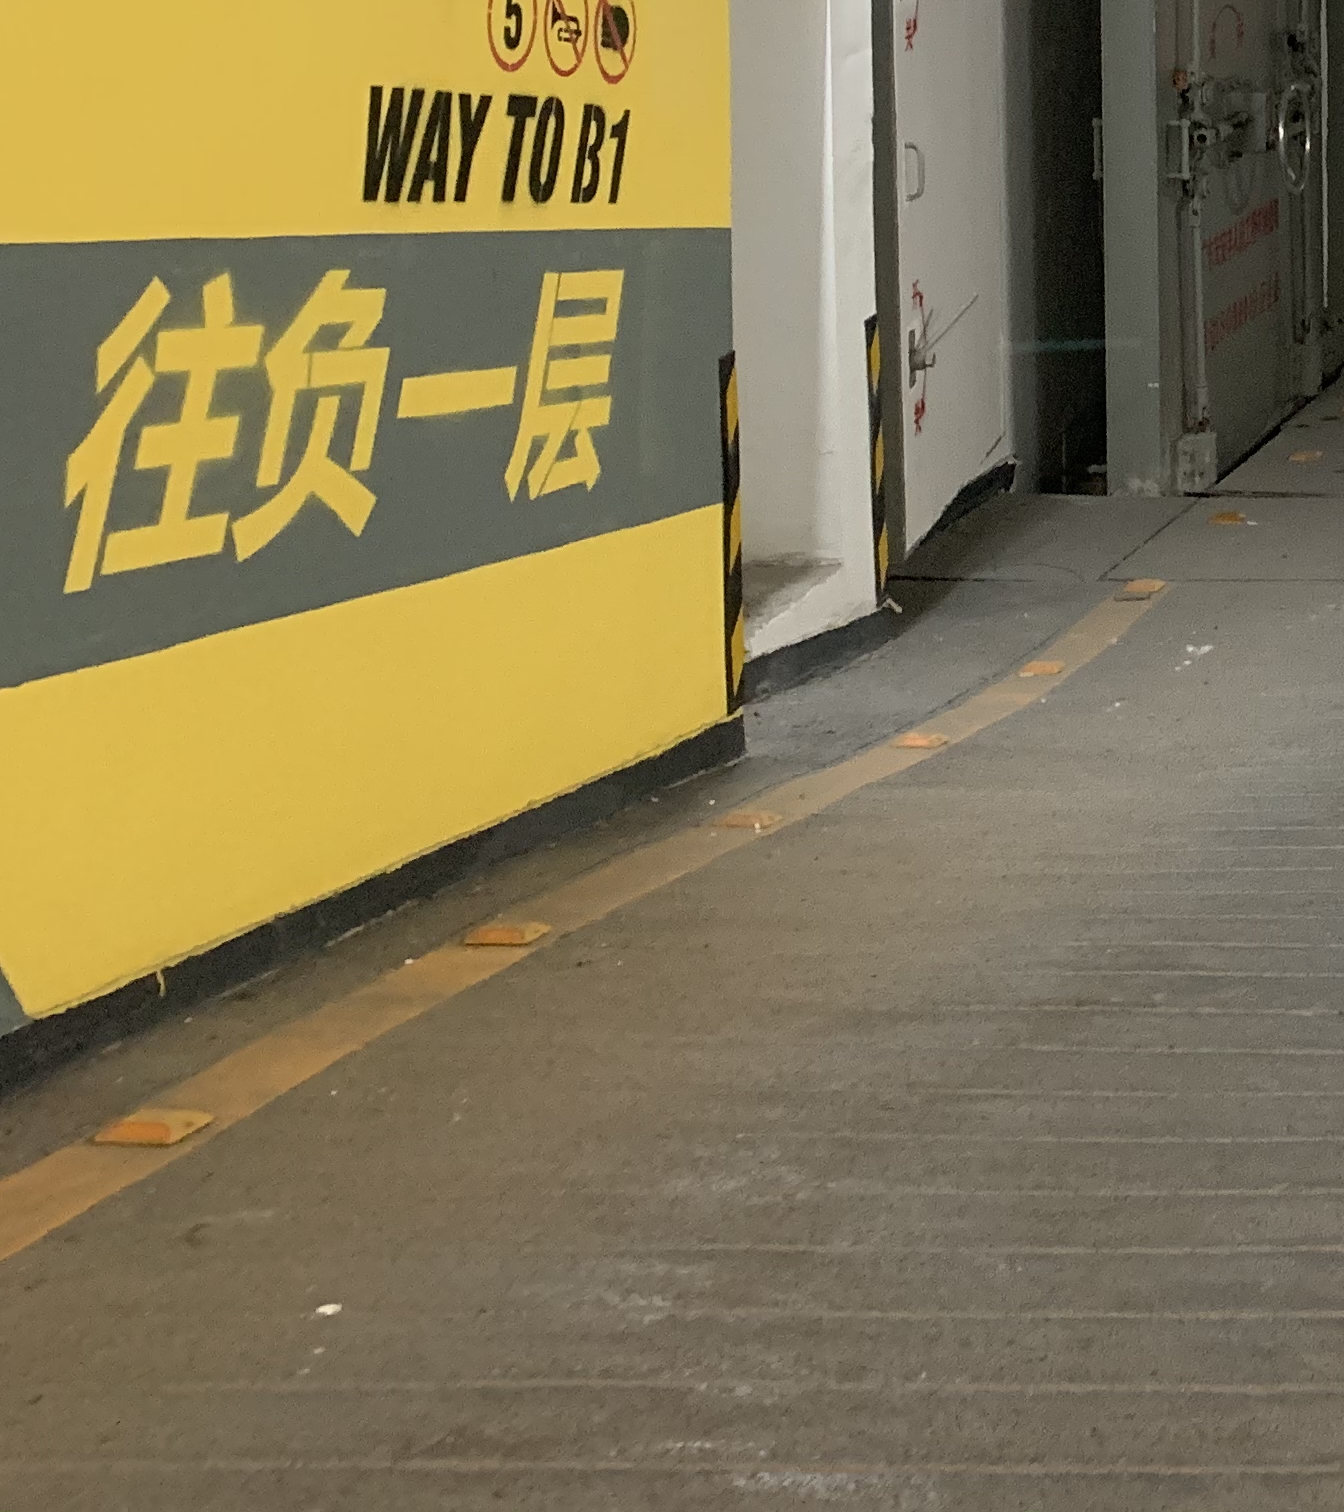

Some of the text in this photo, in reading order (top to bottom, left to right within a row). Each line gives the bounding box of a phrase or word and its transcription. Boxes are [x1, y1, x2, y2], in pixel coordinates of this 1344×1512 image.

[363, 86, 631, 204] WAY TO B1
[63, 269, 625, 594] 往负一层
